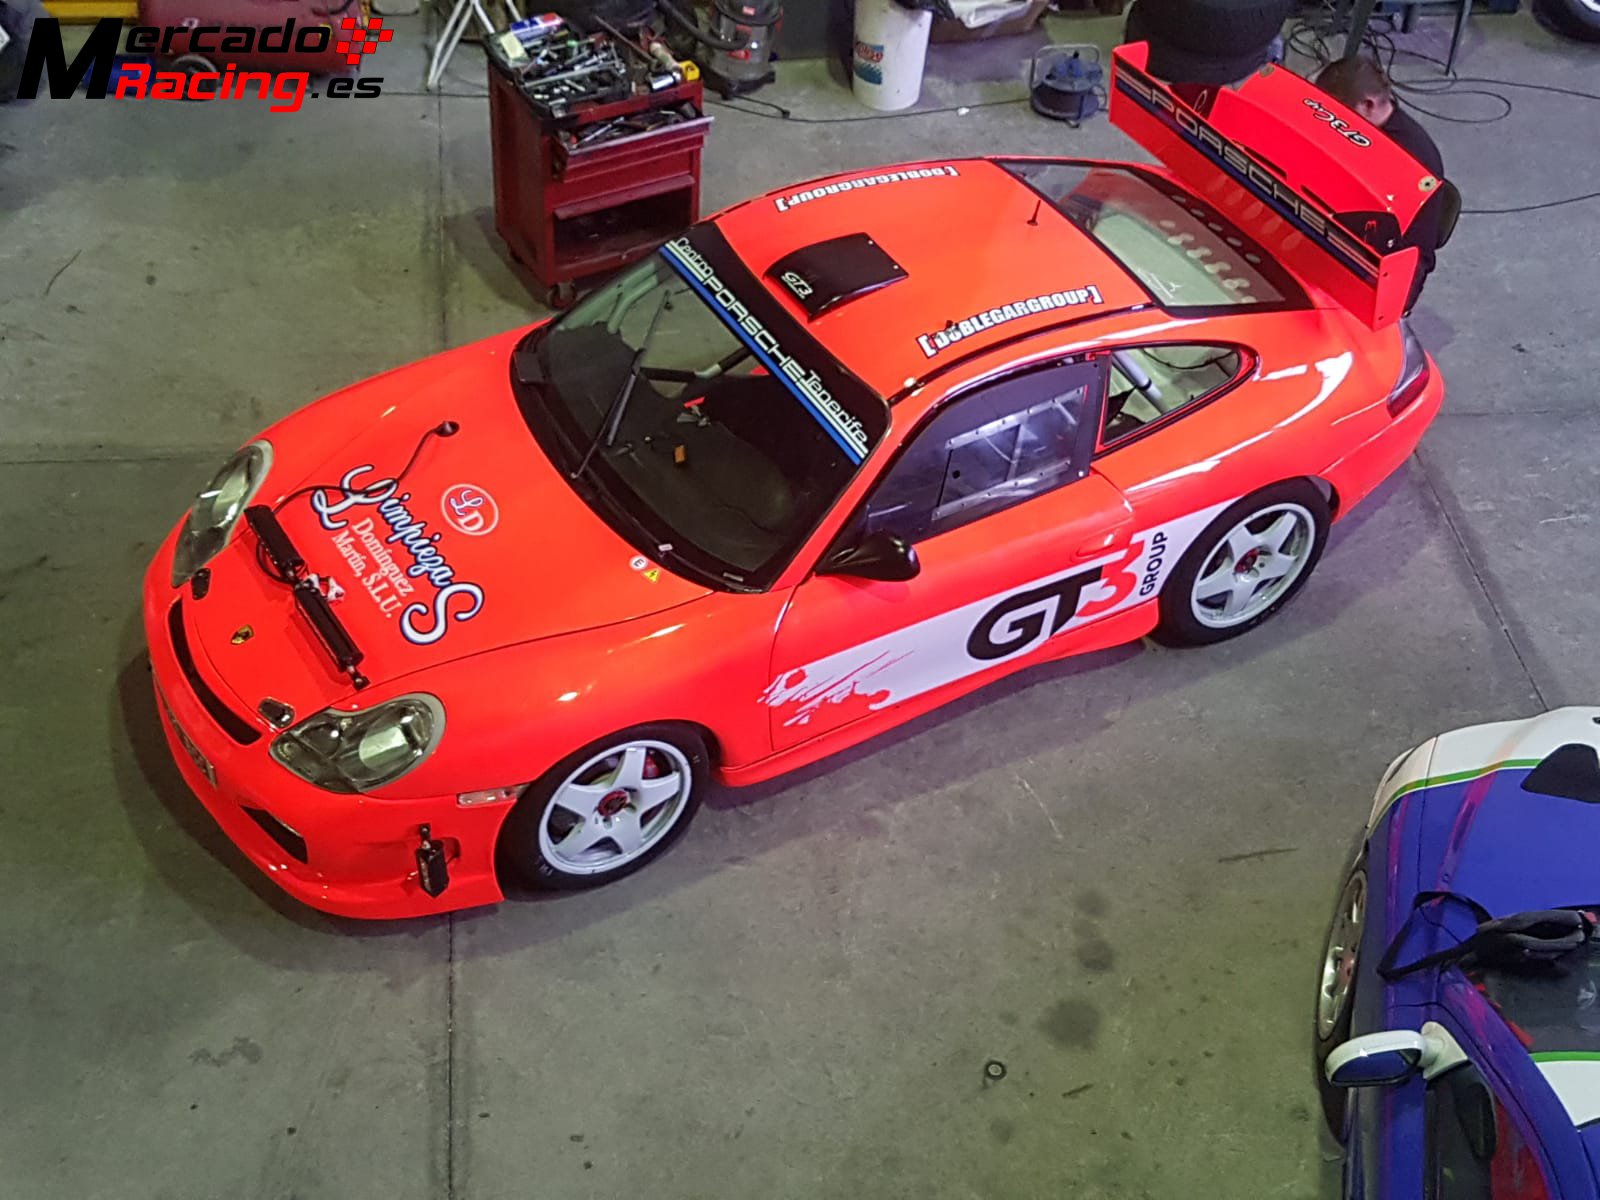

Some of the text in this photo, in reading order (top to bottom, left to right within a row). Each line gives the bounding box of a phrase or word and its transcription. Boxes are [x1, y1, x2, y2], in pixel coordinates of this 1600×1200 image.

[1151, 87, 1327, 236] PORSCHE
[782, 271, 813, 299] GT3
[676, 236, 868, 445] Centro PORSCHE Tenerife
[351, 516, 415, 597] Domínguez
[966, 540, 1145, 661] GT3
[1139, 531, 1169, 597] GROUP
